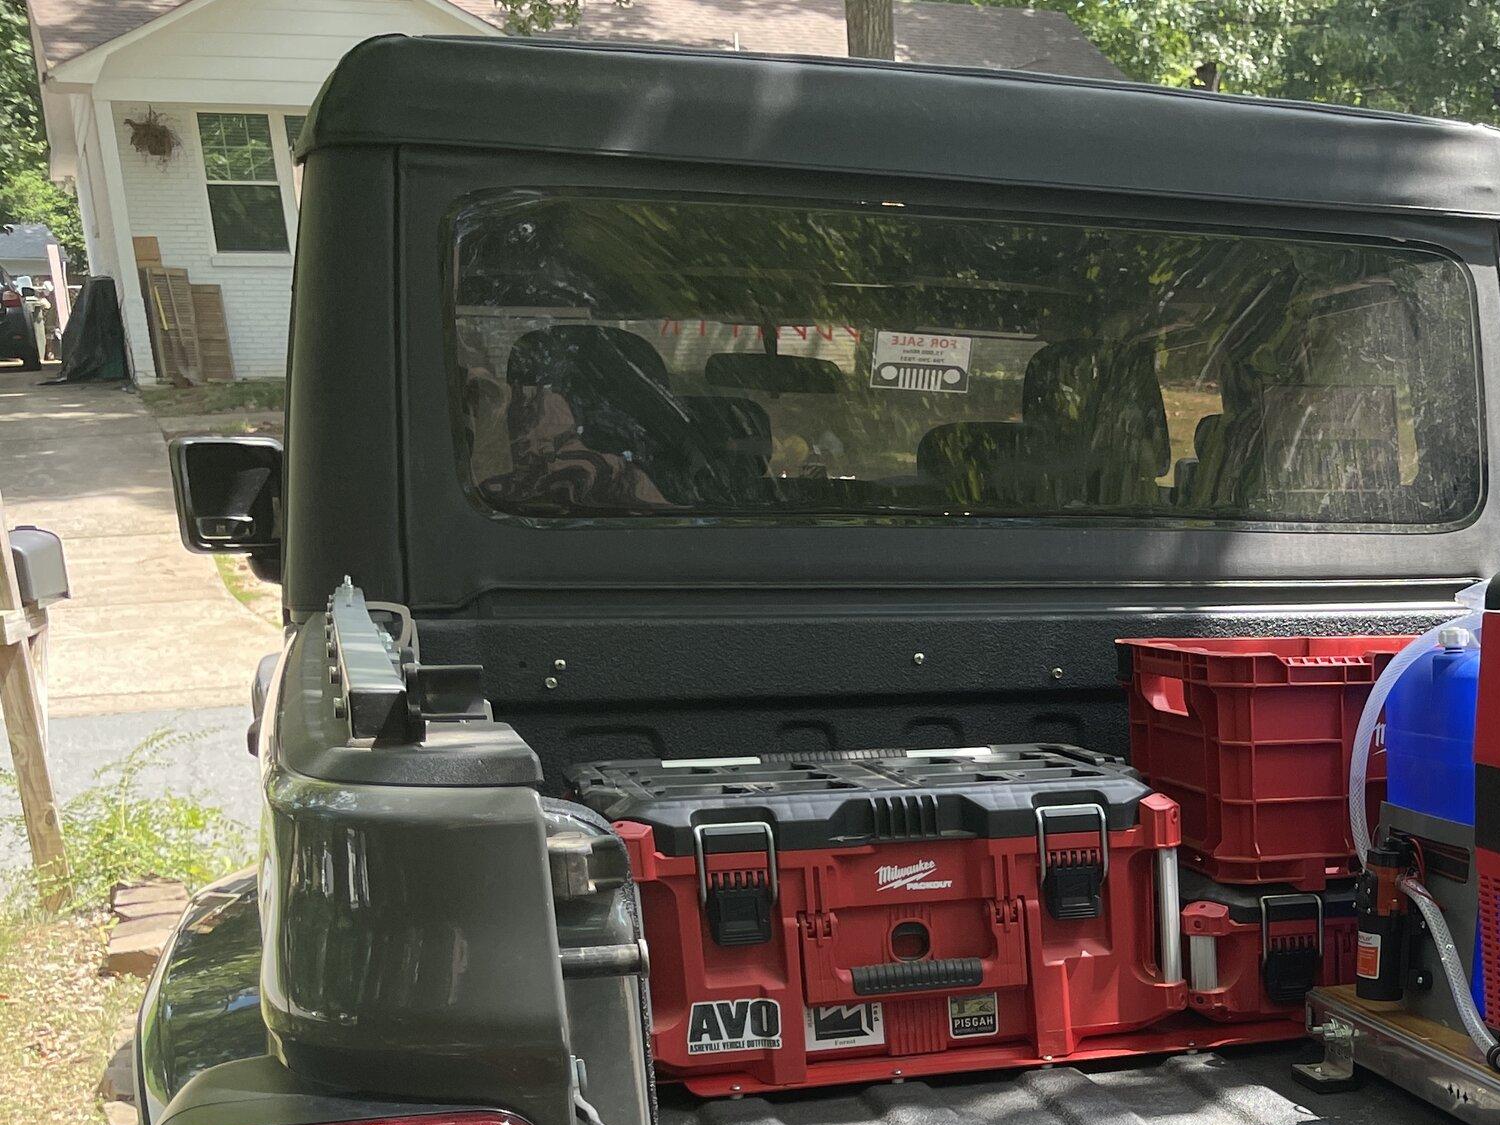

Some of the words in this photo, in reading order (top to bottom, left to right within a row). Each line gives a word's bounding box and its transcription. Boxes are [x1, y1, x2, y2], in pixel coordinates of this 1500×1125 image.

[874, 859, 936, 885] Milwaukee
[906, 880, 953, 890] PACKOUT
[689, 1000, 780, 1042] AVO
[954, 1015, 993, 1028] PISGAH
[689, 1041, 720, 1053] ASHEVILLE
[722, 1040, 745, 1051] VEHICLE
[747, 1038, 780, 1049] OUTFITTERS
